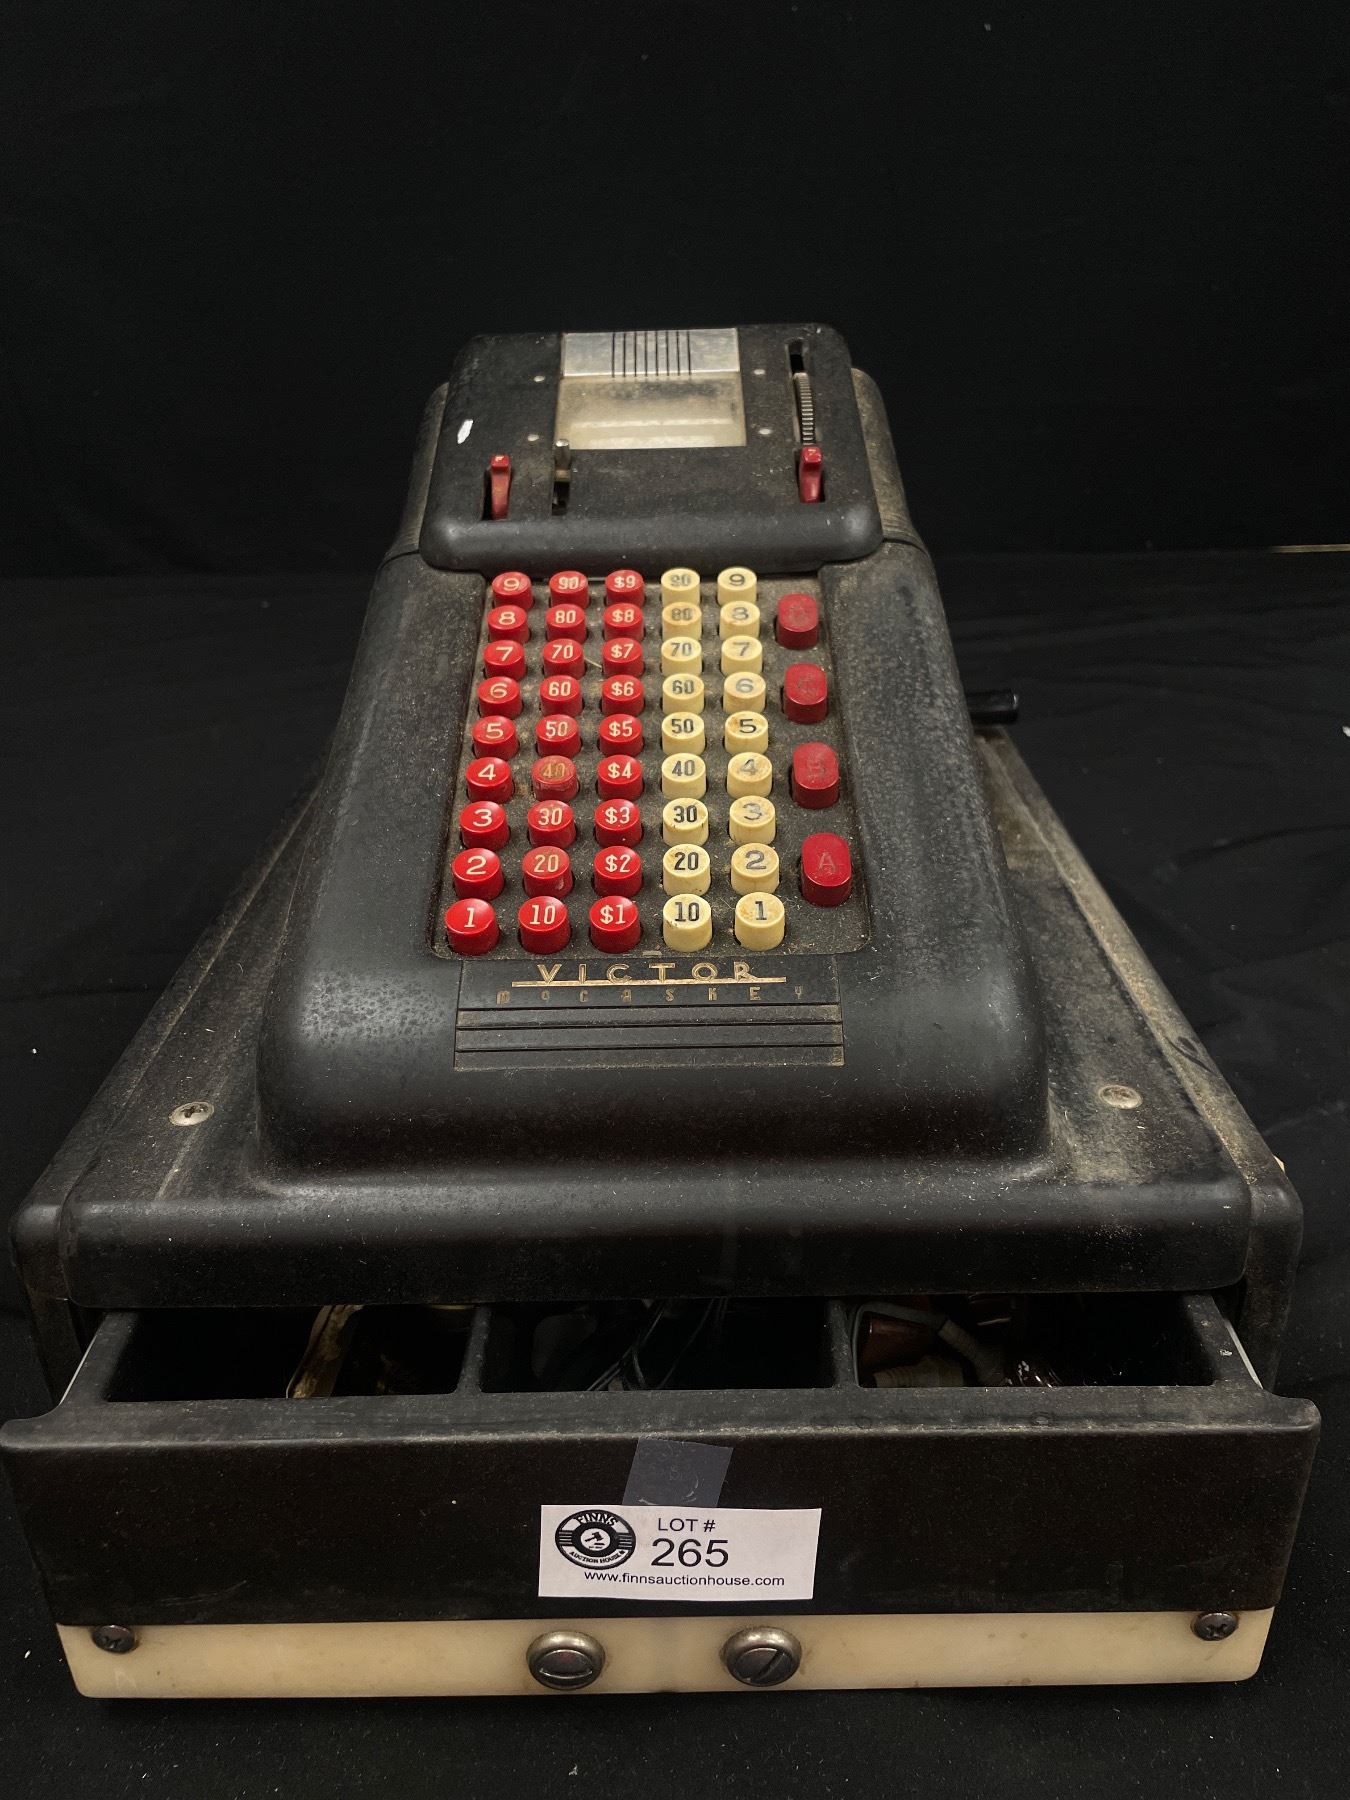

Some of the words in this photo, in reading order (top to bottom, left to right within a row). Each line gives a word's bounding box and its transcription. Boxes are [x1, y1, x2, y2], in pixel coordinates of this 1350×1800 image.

[504, 578, 520, 591] 9
[558, 577, 579, 589] 90
[614, 576, 636, 588] $9
[729, 574, 745, 586] 9
[499, 611, 515, 625] 8
[555, 610, 576, 623] 80
[612, 609, 634, 622] $8
[496, 646, 513, 661] 7
[552, 645, 573, 659] 70
[610, 643, 634, 659] $7
[670, 643, 692, 656] 70
[733, 642, 751, 656] 7
[490, 683, 507, 698] 6
[549, 682, 571, 696] 60
[611, 682, 634, 696] $6
[672, 680, 694, 694] 60
[736, 678, 754, 693] 6
[485, 723, 504, 739] 5
[545, 721, 568, 737] 50
[608, 720, 633, 737] $5
[671, 719, 694, 733] 50
[739, 719, 756, 733] 5
[478, 764, 496, 780] 4
[608, 762, 632, 778] $4
[672, 760, 695, 776] 40
[739, 759, 756, 775] 4
[473, 809, 493, 827] 3
[538, 808, 563, 825] 30
[605, 806, 630, 824] $3
[673, 805, 698, 823] 30
[742, 803, 763, 821] 3
[466, 856, 487, 875] 2
[534, 854, 559, 872] 20
[605, 854, 631, 872] $2
[674, 852, 699, 870] 20
[745, 850, 766, 869] 2
[818, 851, 836, 873] A
[464, 907, 475, 928] 1
[529, 905, 556, 925] 10
[600, 904, 626, 925] $1
[674, 902, 700, 922] 10
[754, 901, 767, 921] 1
[537, 961, 761, 983] VICTOR
[577, 1512, 616, 1525] FINNS
[657, 1517, 699, 1532] LOT
[703, 1519, 716, 1533] #
[569, 1551, 599, 1563] AUCTION
[650, 1537, 730, 1568] 265
[584, 1571, 785, 1587] www.finnsauctionhouse.com
